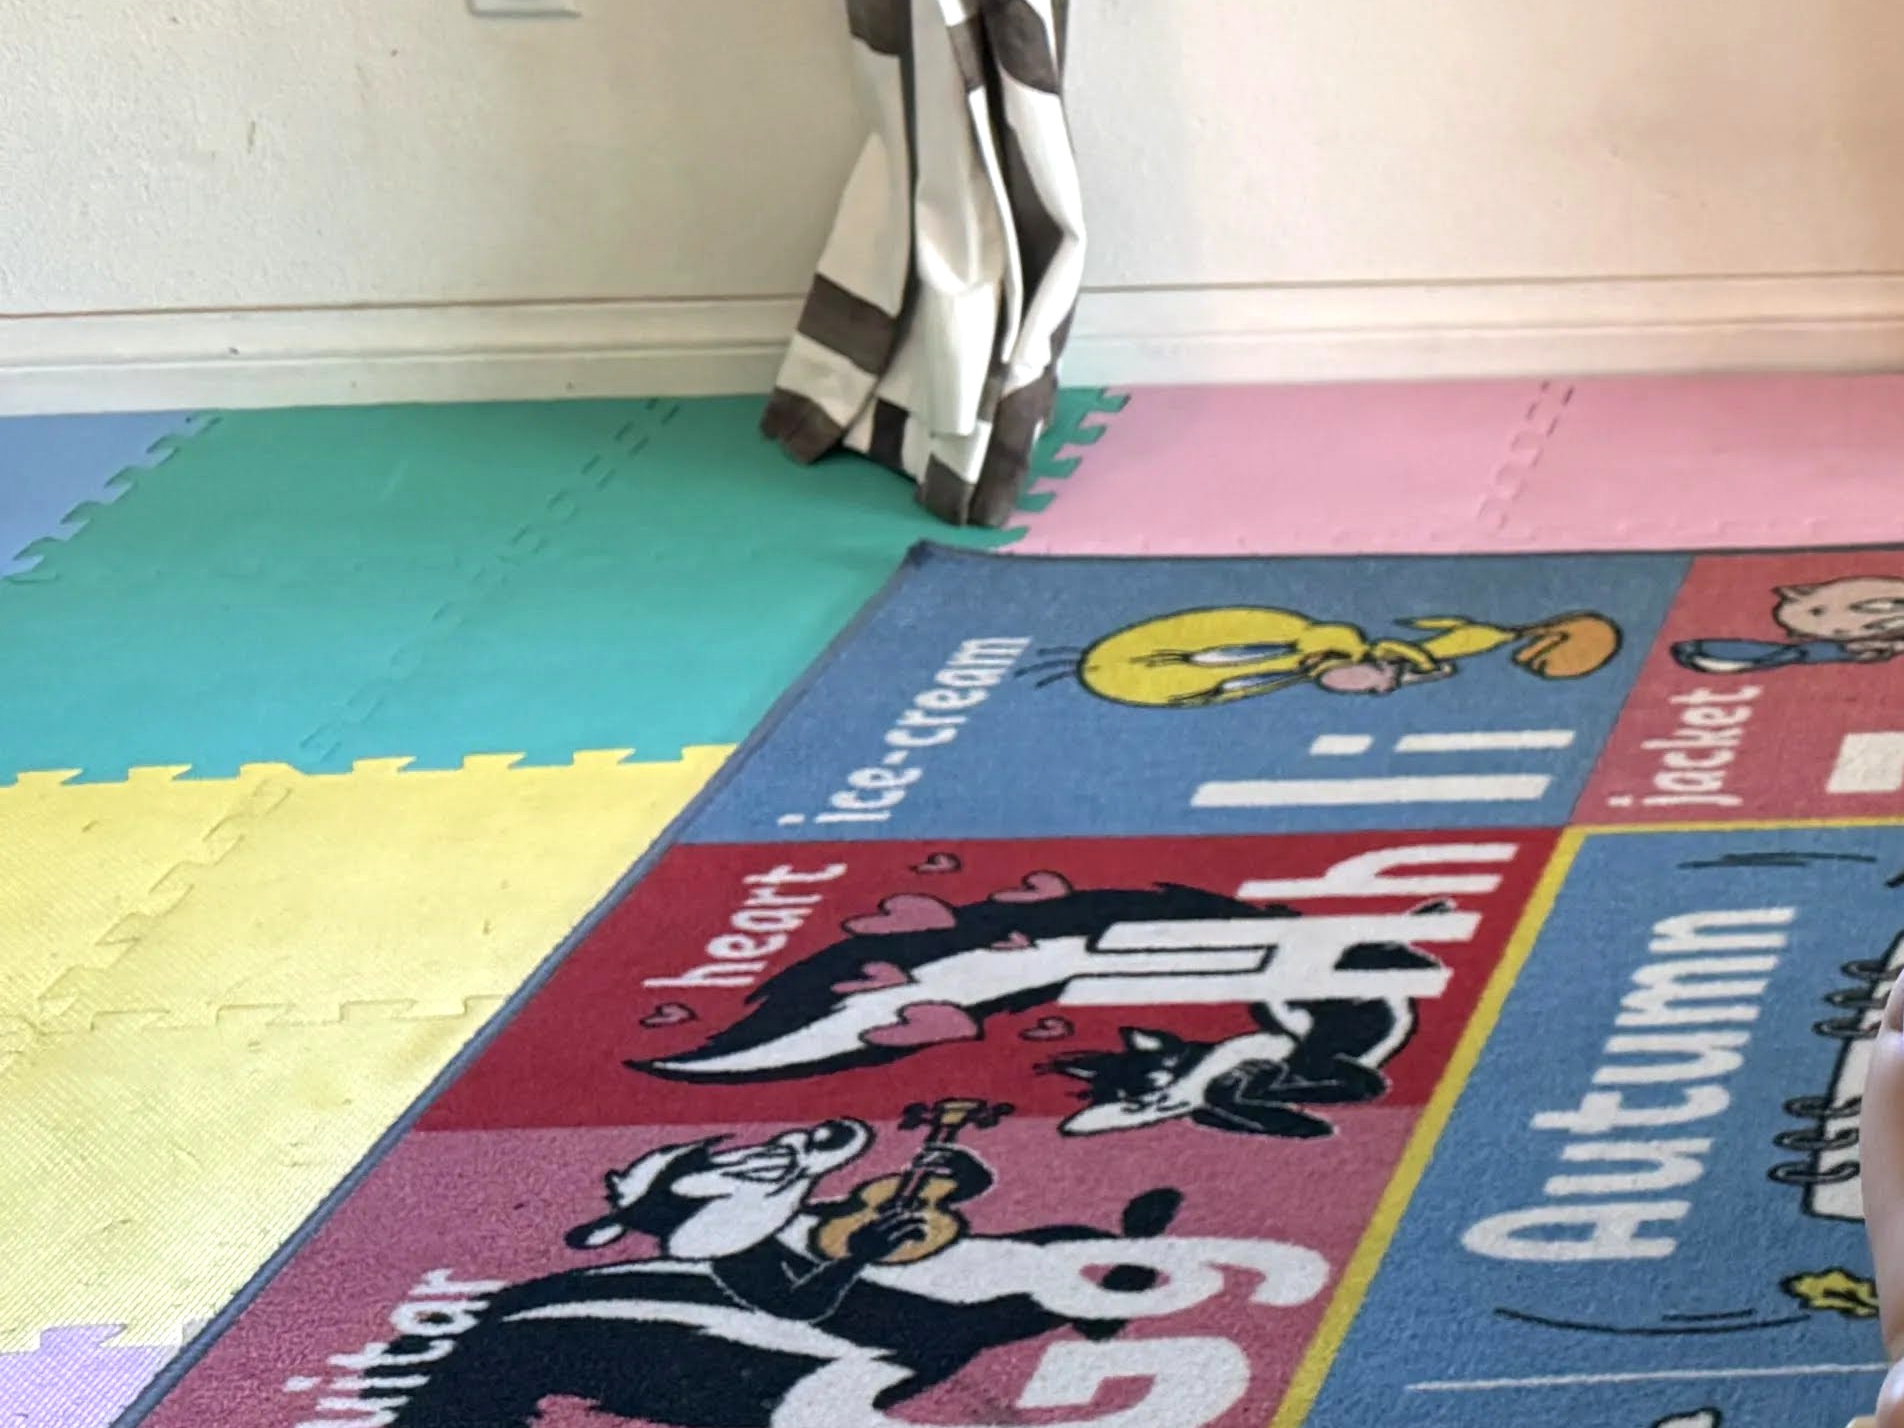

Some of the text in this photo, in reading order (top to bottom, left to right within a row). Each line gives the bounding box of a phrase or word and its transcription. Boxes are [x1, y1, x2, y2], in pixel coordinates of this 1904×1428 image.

[777, 636, 1033, 825] ice-cream
[1608, 684, 1765, 807] jacket
[642, 863, 847, 988] heart
[1059, 842, 1519, 1006] Hh
[1459, 904, 1795, 1264] Autumn
